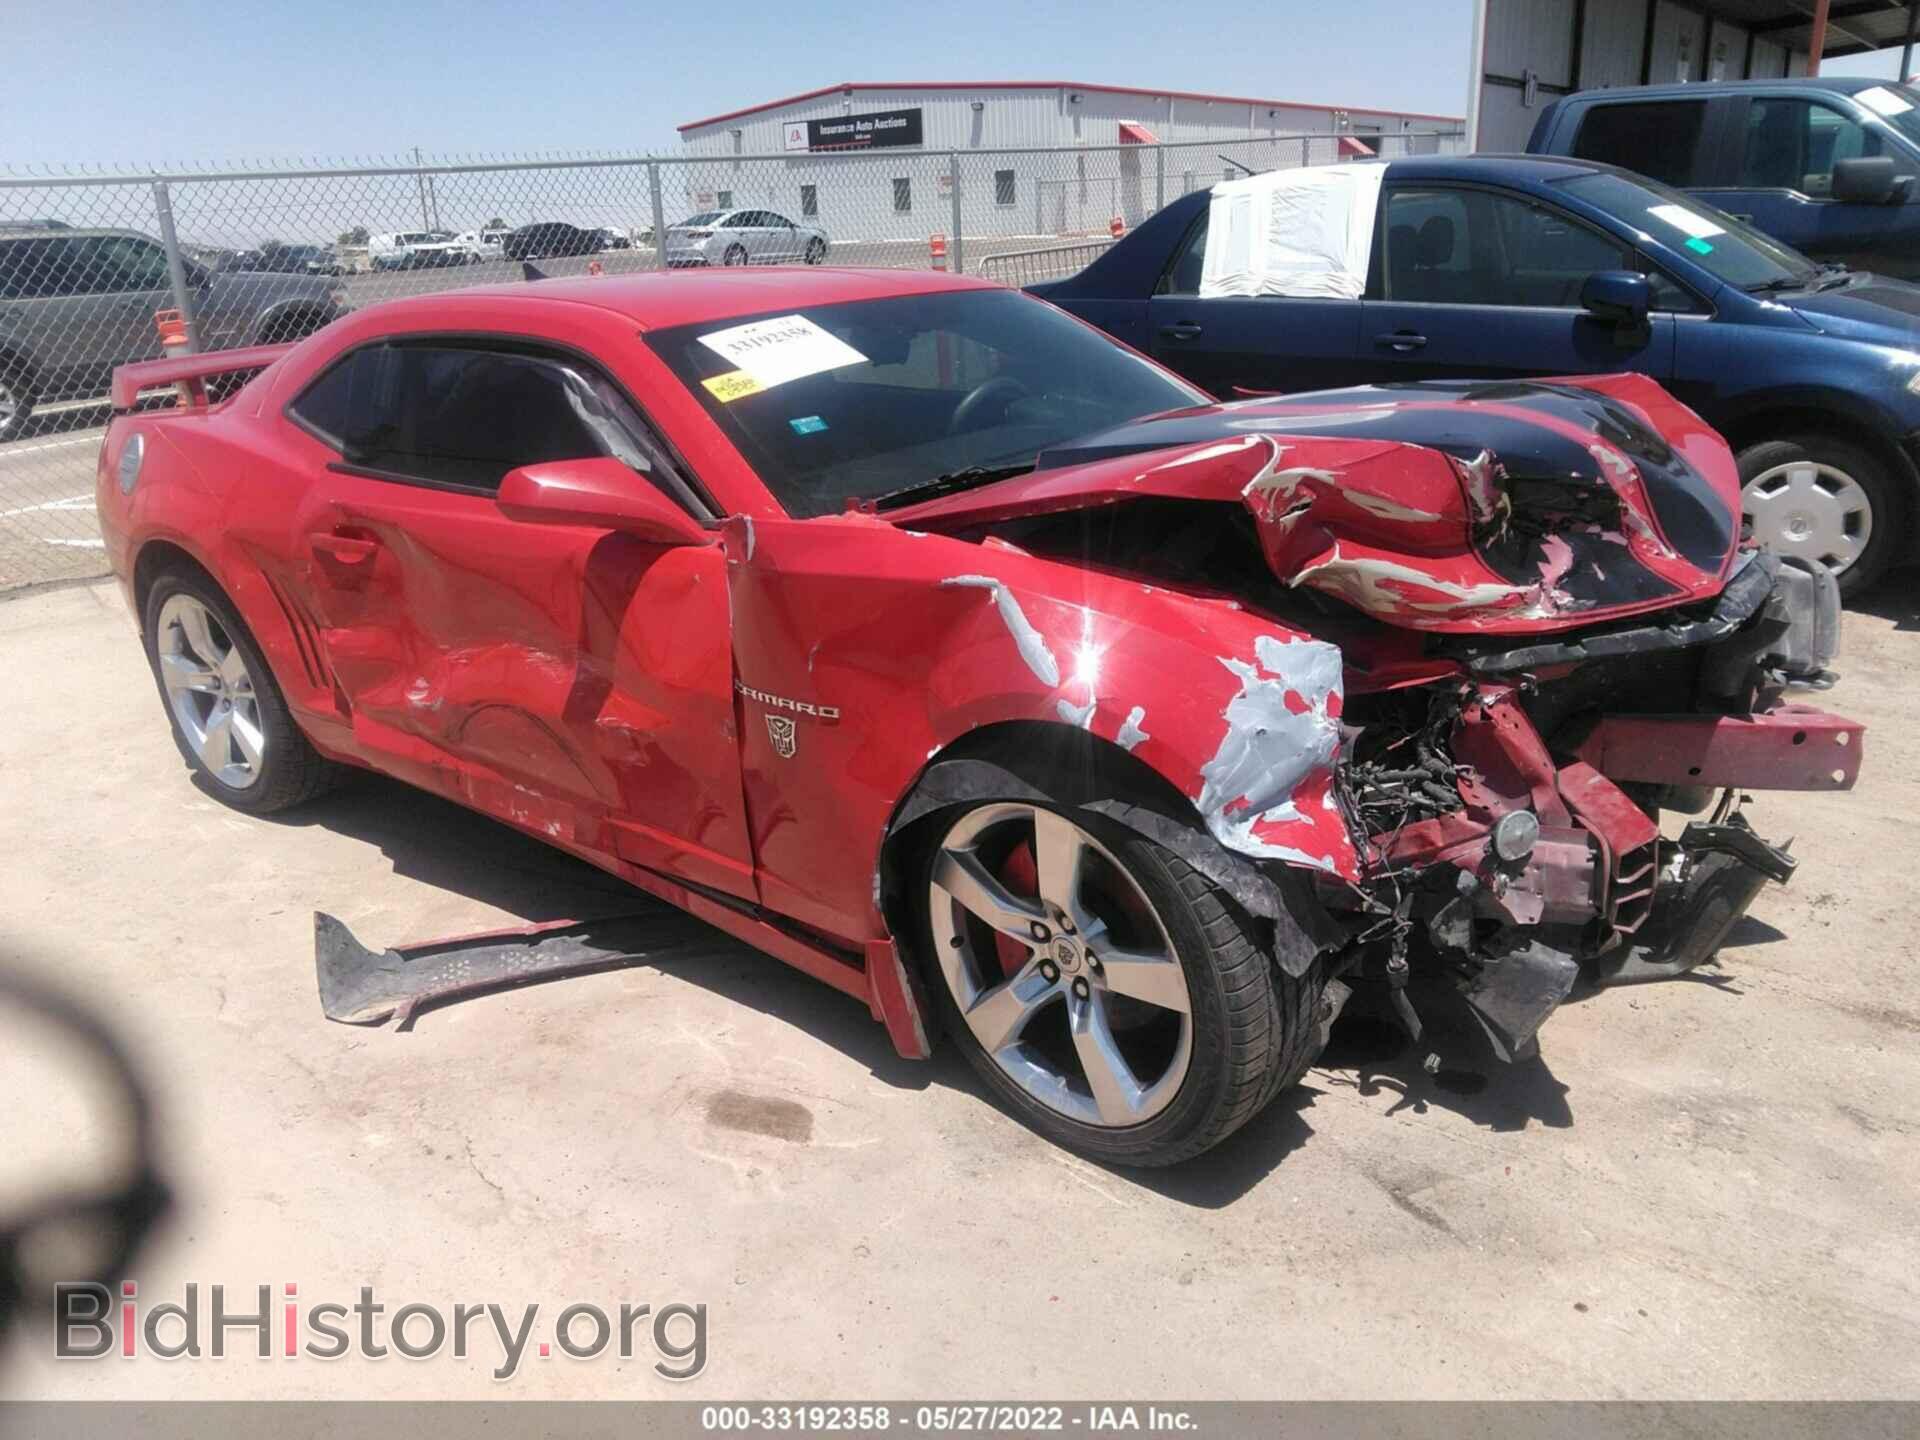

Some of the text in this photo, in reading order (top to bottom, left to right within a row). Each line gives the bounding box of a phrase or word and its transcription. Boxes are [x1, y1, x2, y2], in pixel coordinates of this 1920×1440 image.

[820, 117, 907, 135] Insurance Auto Auctions
